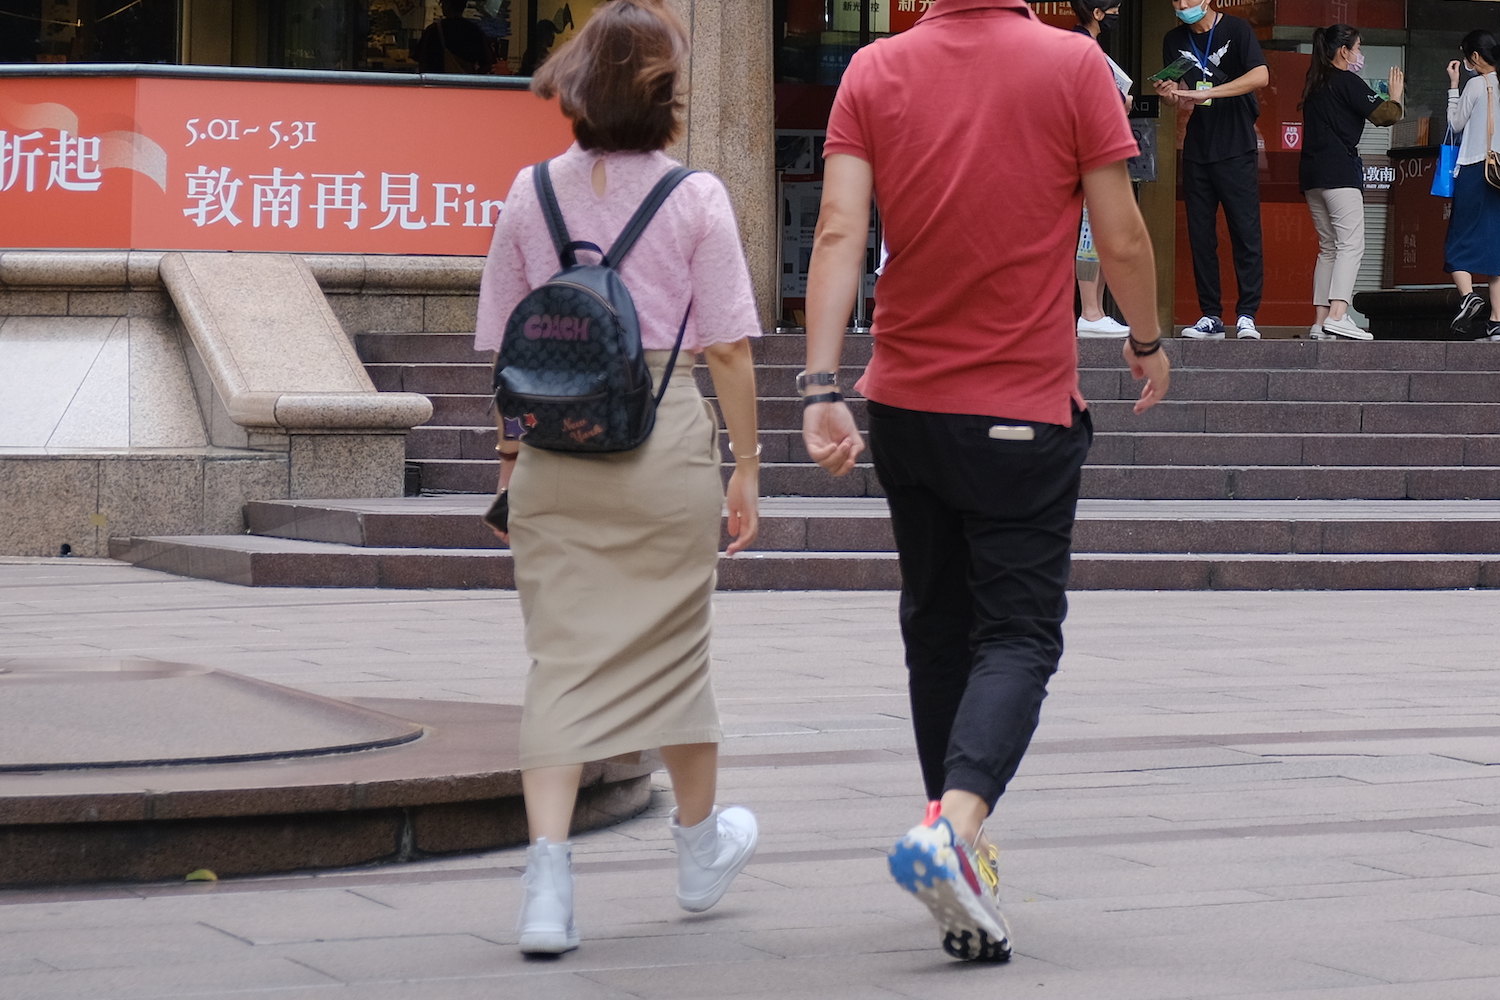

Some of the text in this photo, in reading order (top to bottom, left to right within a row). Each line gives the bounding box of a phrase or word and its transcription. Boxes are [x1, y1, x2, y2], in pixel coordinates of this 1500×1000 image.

[842, 1, 880, 12] 新光控
[523, 314, 591, 341] COACH
